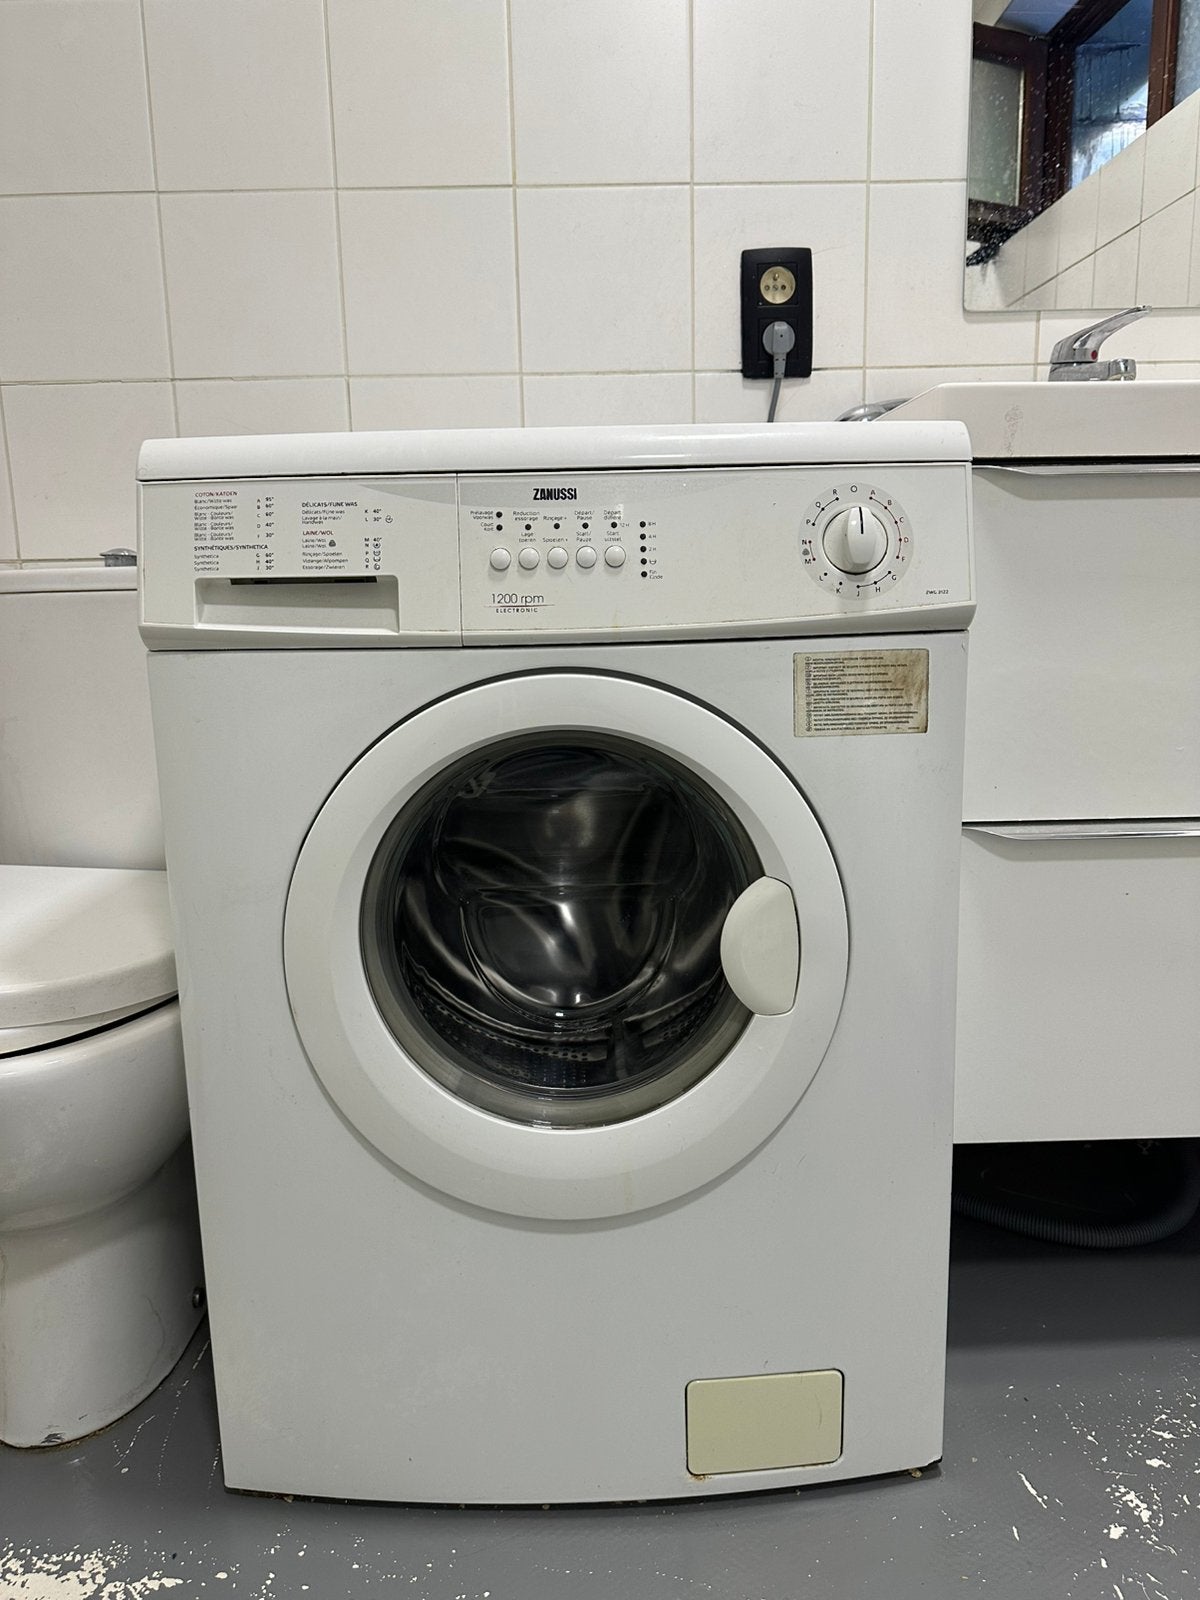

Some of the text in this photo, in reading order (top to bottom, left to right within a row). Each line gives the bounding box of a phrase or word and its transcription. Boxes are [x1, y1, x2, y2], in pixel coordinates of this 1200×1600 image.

[533, 488, 577, 500] ZANUSSI
[815, 501, 822, 509] Q
[492, 593, 545, 606] 1200 rpm
